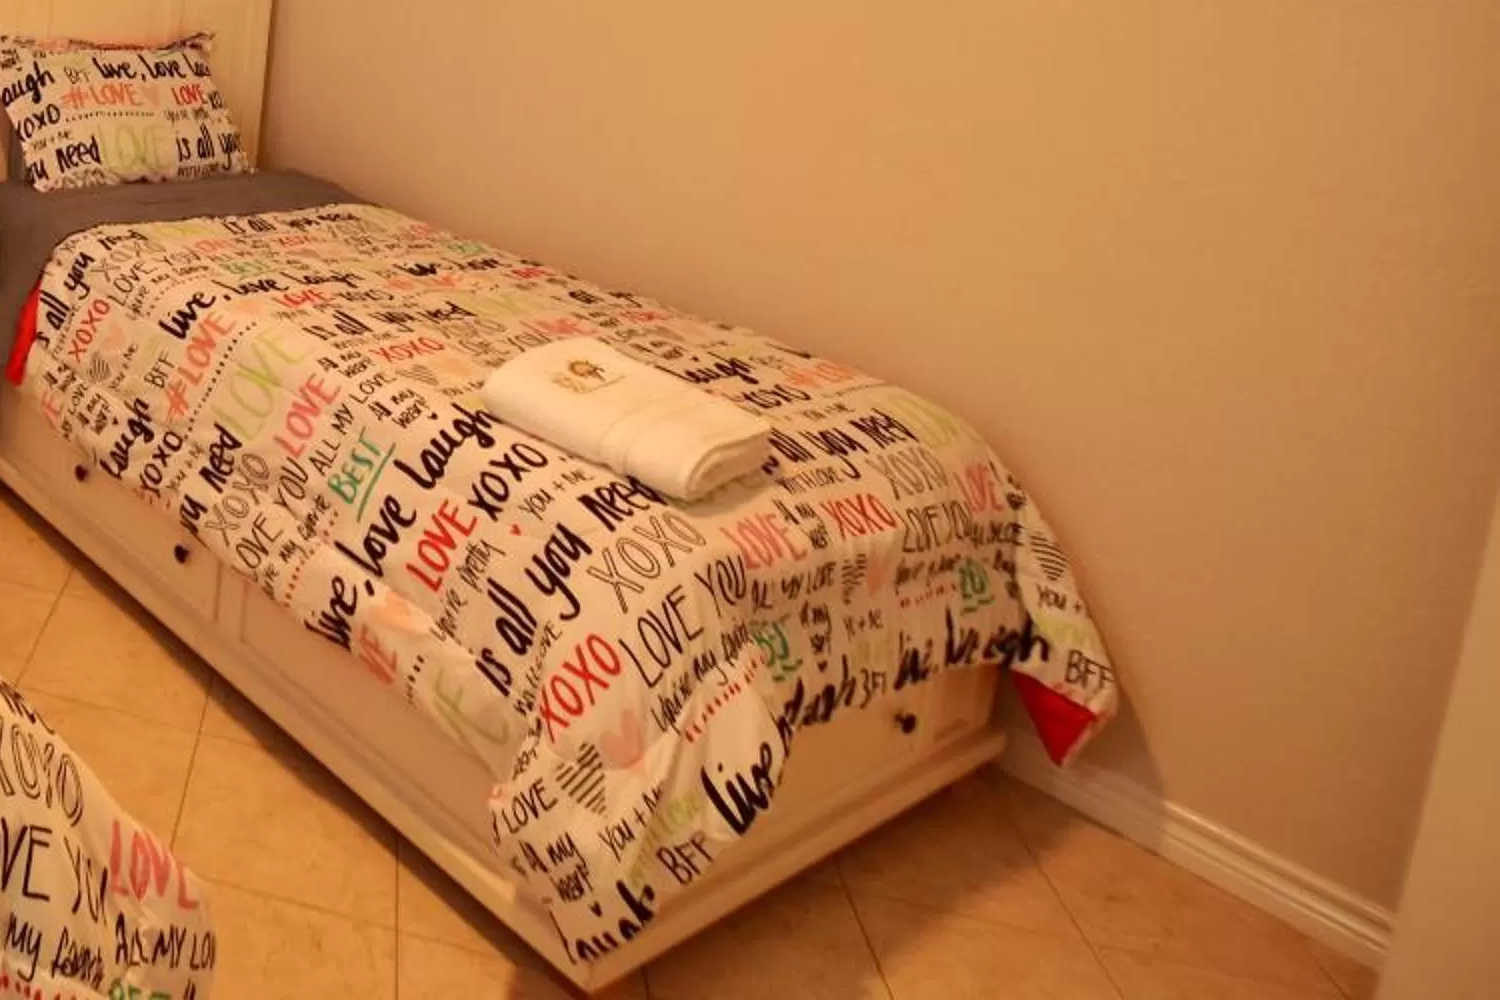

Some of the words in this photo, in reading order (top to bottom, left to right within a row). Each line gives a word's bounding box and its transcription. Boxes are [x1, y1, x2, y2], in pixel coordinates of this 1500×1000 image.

[56, 136, 100, 175] need
[67, 298, 111, 363] XOXO
[165, 310, 236, 419] #LOVE
[273, 373, 342, 459] LOVE
[308, 439, 341, 477] ALL
[332, 409, 354, 436] MY
[351, 372, 398, 404] LOVE
[199, 421, 243, 494] need
[273, 455, 309, 522] YOU
[328, 426, 383, 505] BEST
[334, 494, 417, 578] love
[393, 402, 506, 491] laugh
[468, 442, 549, 522] XOXO
[204, 452, 270, 547] XOXO
[519, 488, 555, 521] YOU
[820, 492, 897, 542] XOXO
[405, 499, 477, 592] LOVE
[524, 522, 593, 621] you
[586, 510, 707, 614] XOXO
[719, 512, 808, 569] LOVE
[487, 577, 538, 656] all
[618, 584, 705, 689] LOVE
[694, 555, 747, 618] YOU
[475, 647, 513, 697] is
[539, 633, 621, 744] XOXO
[1065, 649, 1117, 692] BFF
[500, 778, 558, 835] LOVE
[700, 742, 774, 835] live
[109, 820, 199, 911] LOVE
[599, 823, 635, 862] YOU
[656, 833, 714, 886] BFF
